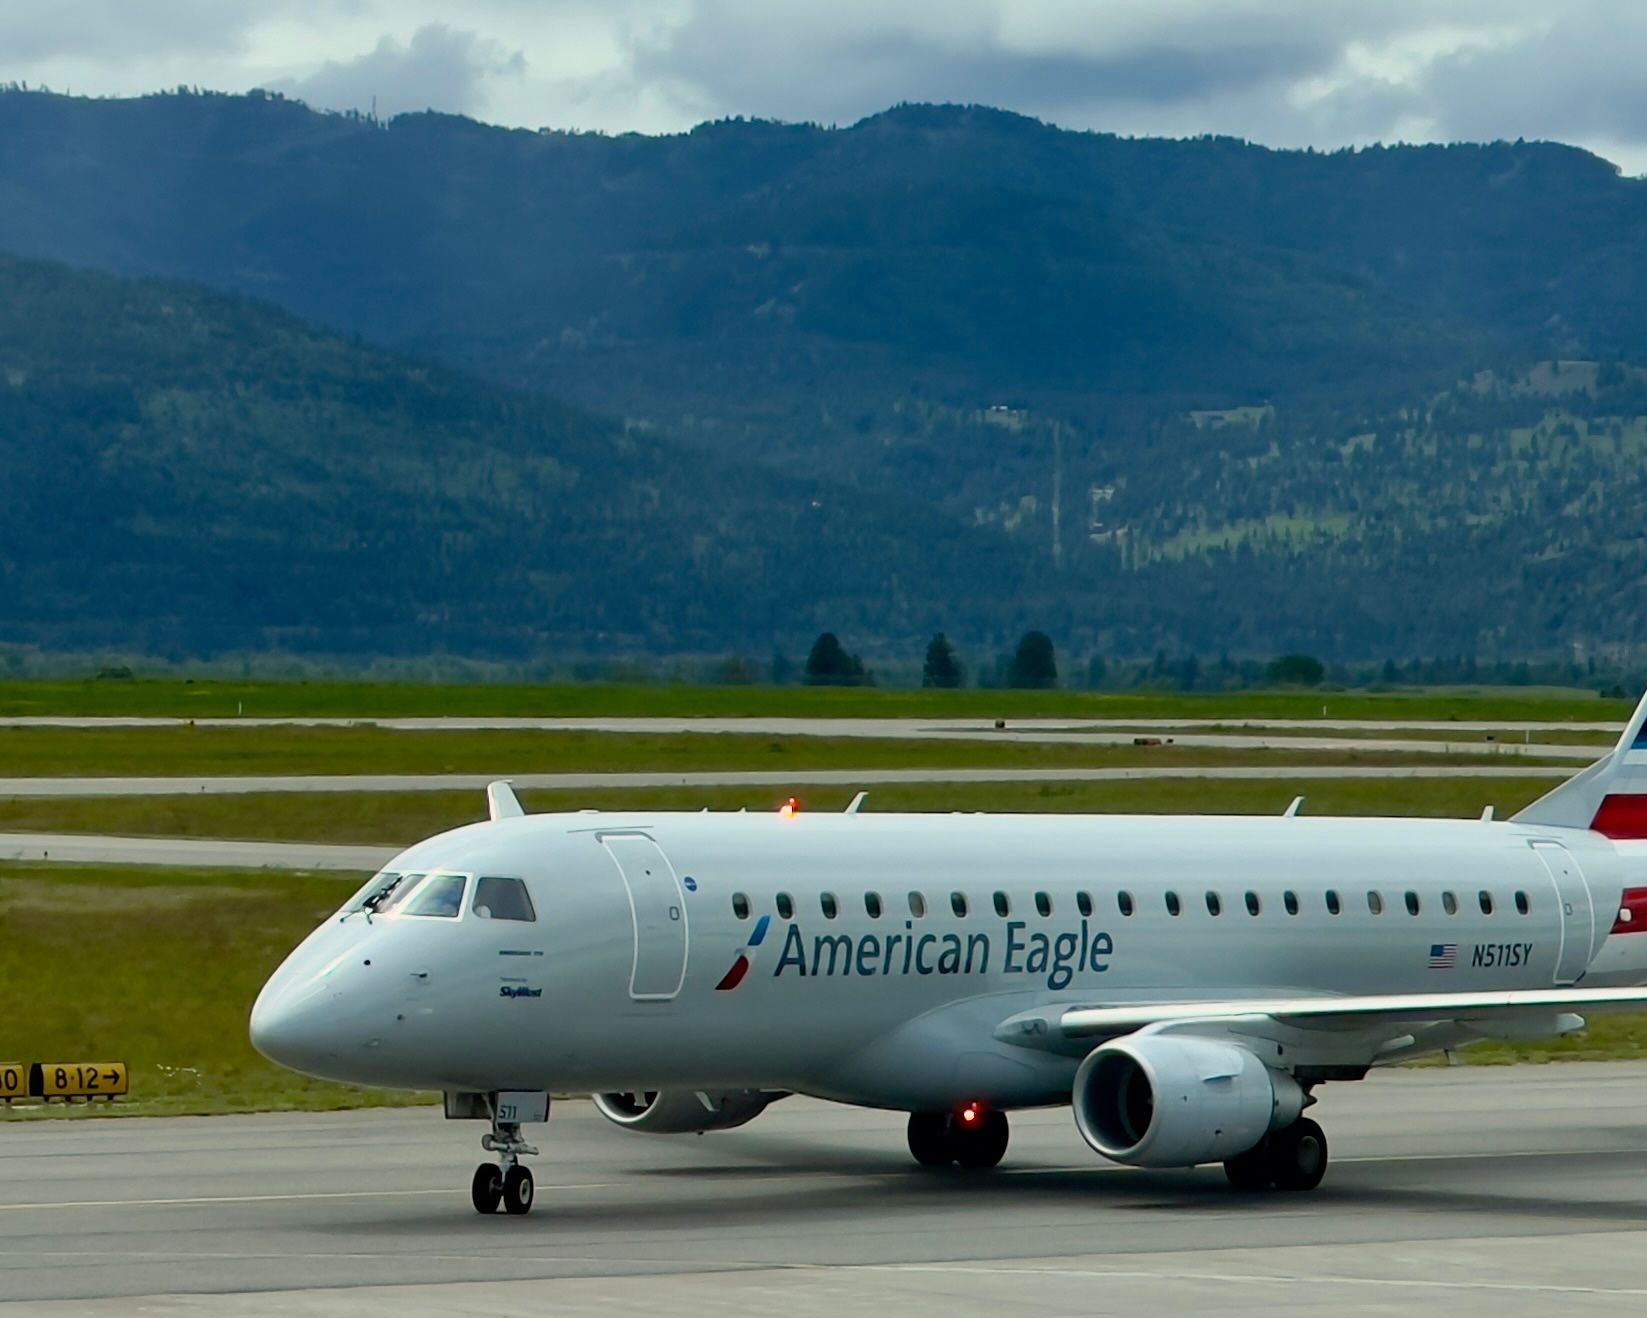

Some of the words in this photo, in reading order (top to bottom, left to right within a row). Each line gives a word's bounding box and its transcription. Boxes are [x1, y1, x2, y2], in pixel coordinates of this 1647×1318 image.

[773, 919, 990, 977] American
[1003, 919, 1113, 991] Eagle
[1472, 943, 1534, 968] N511SY
[499, 1105, 518, 1119] 511
